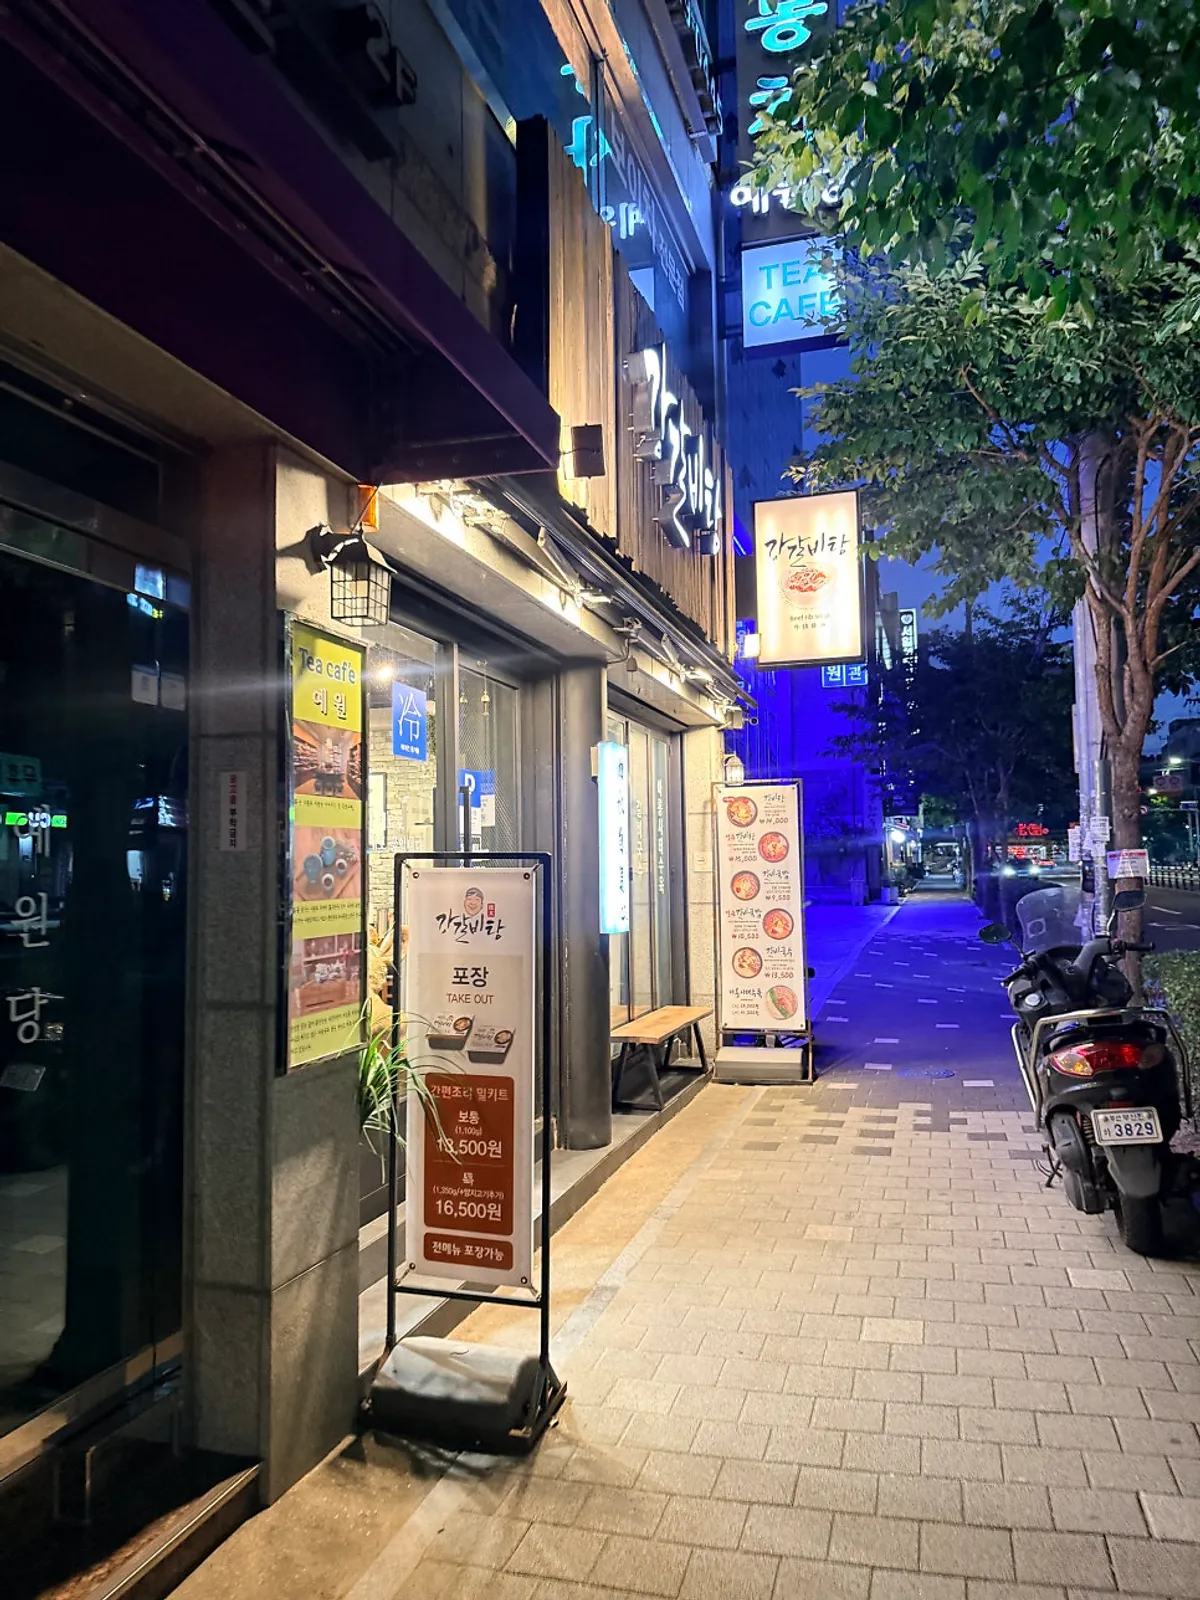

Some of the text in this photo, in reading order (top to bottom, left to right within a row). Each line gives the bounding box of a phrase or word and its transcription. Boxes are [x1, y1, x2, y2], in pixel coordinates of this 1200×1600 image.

[298, 648, 323, 675] Tea
[452, 966, 489, 988] 포장
[446, 993, 494, 1005] TAKE OUT
[476, 1088, 508, 1102] 밀키트
[458, 1110, 480, 1125] 보통
[1114, 1121, 1154, 1137] 3829
[462, 1172, 474, 1186] 특
[436, 1199, 502, 1221] 16,500원
[432, 1241, 504, 1261] 전메뉴 포장가능
